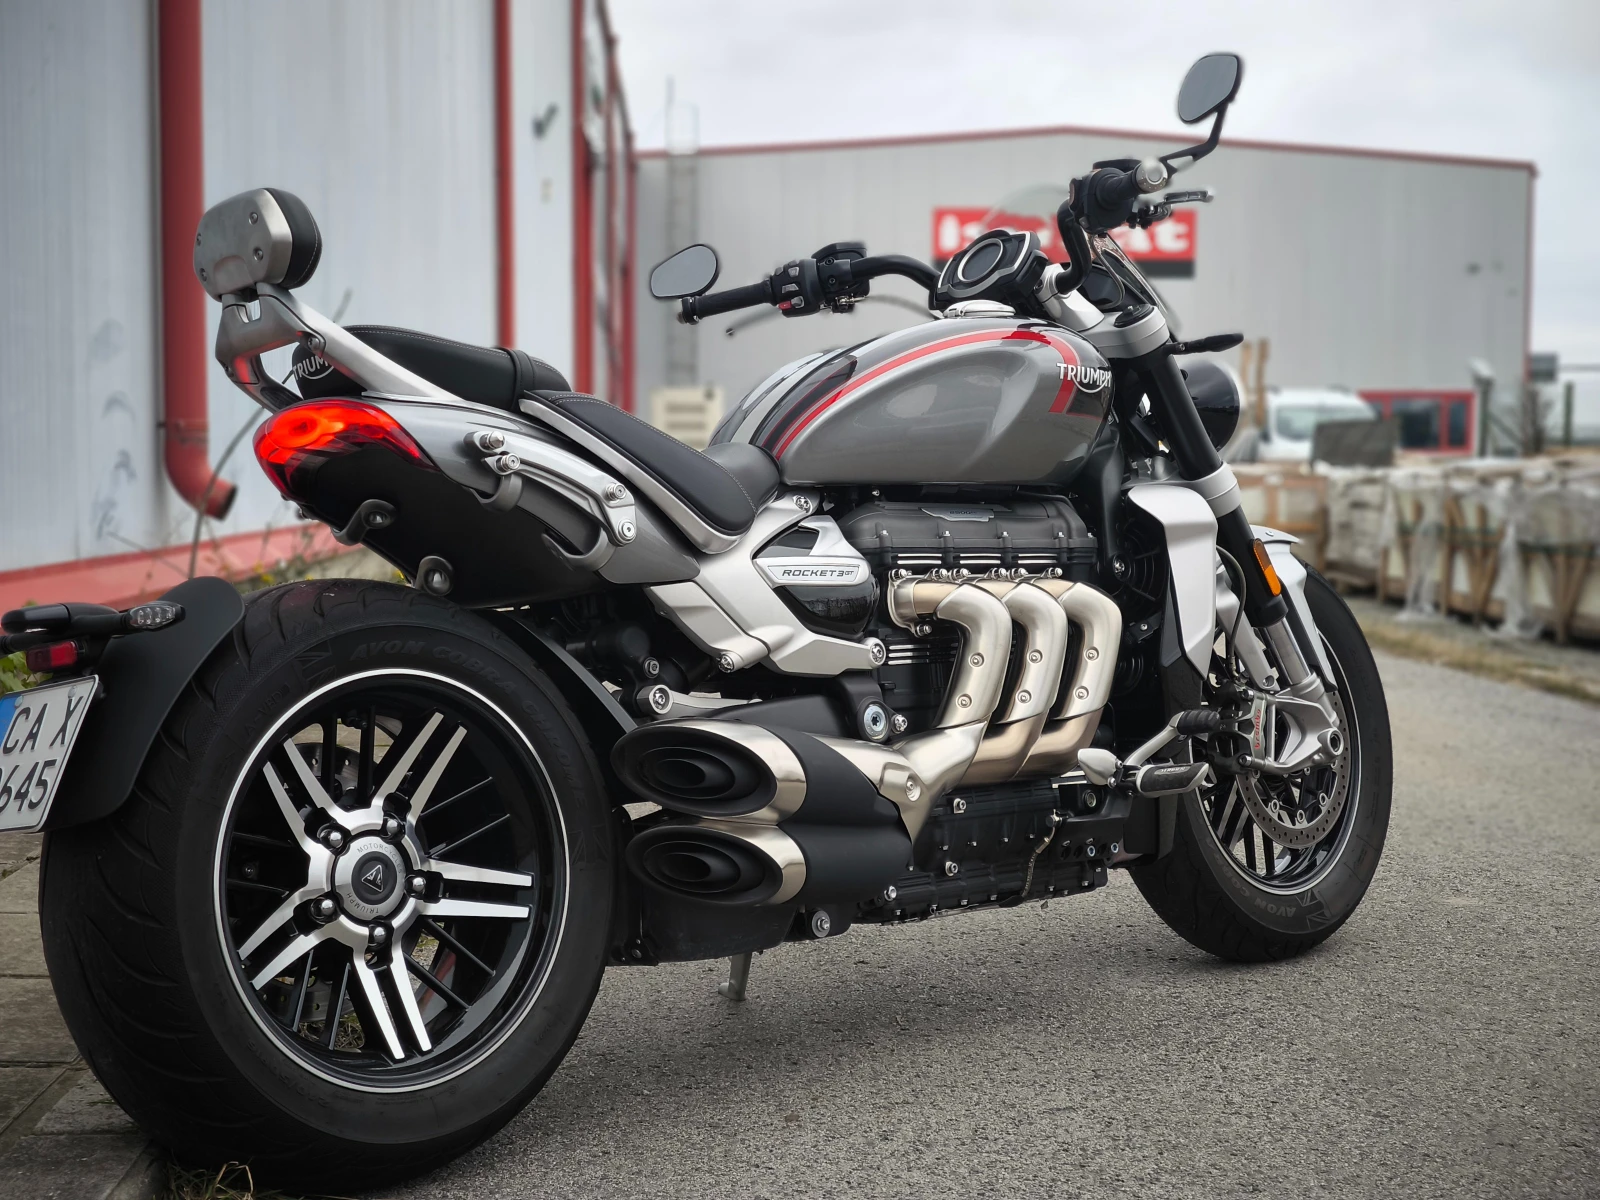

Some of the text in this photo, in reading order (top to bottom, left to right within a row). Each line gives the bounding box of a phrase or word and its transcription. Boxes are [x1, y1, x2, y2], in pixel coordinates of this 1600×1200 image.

[292, 355, 329, 381] TRIUM
[1056, 362, 1112, 388] TRIUMPH
[3, 696, 84, 754] CA X
[349, 640, 588, 810] AVON COBRA CHROME
[1253, 708, 1261, 750] brembo
[0, 759, 57, 813] 645
[356, 842, 403, 874] MOTORCYCLES
[346, 892, 380, 914] TRIUMPH
[1254, 896, 1297, 917] AVON
